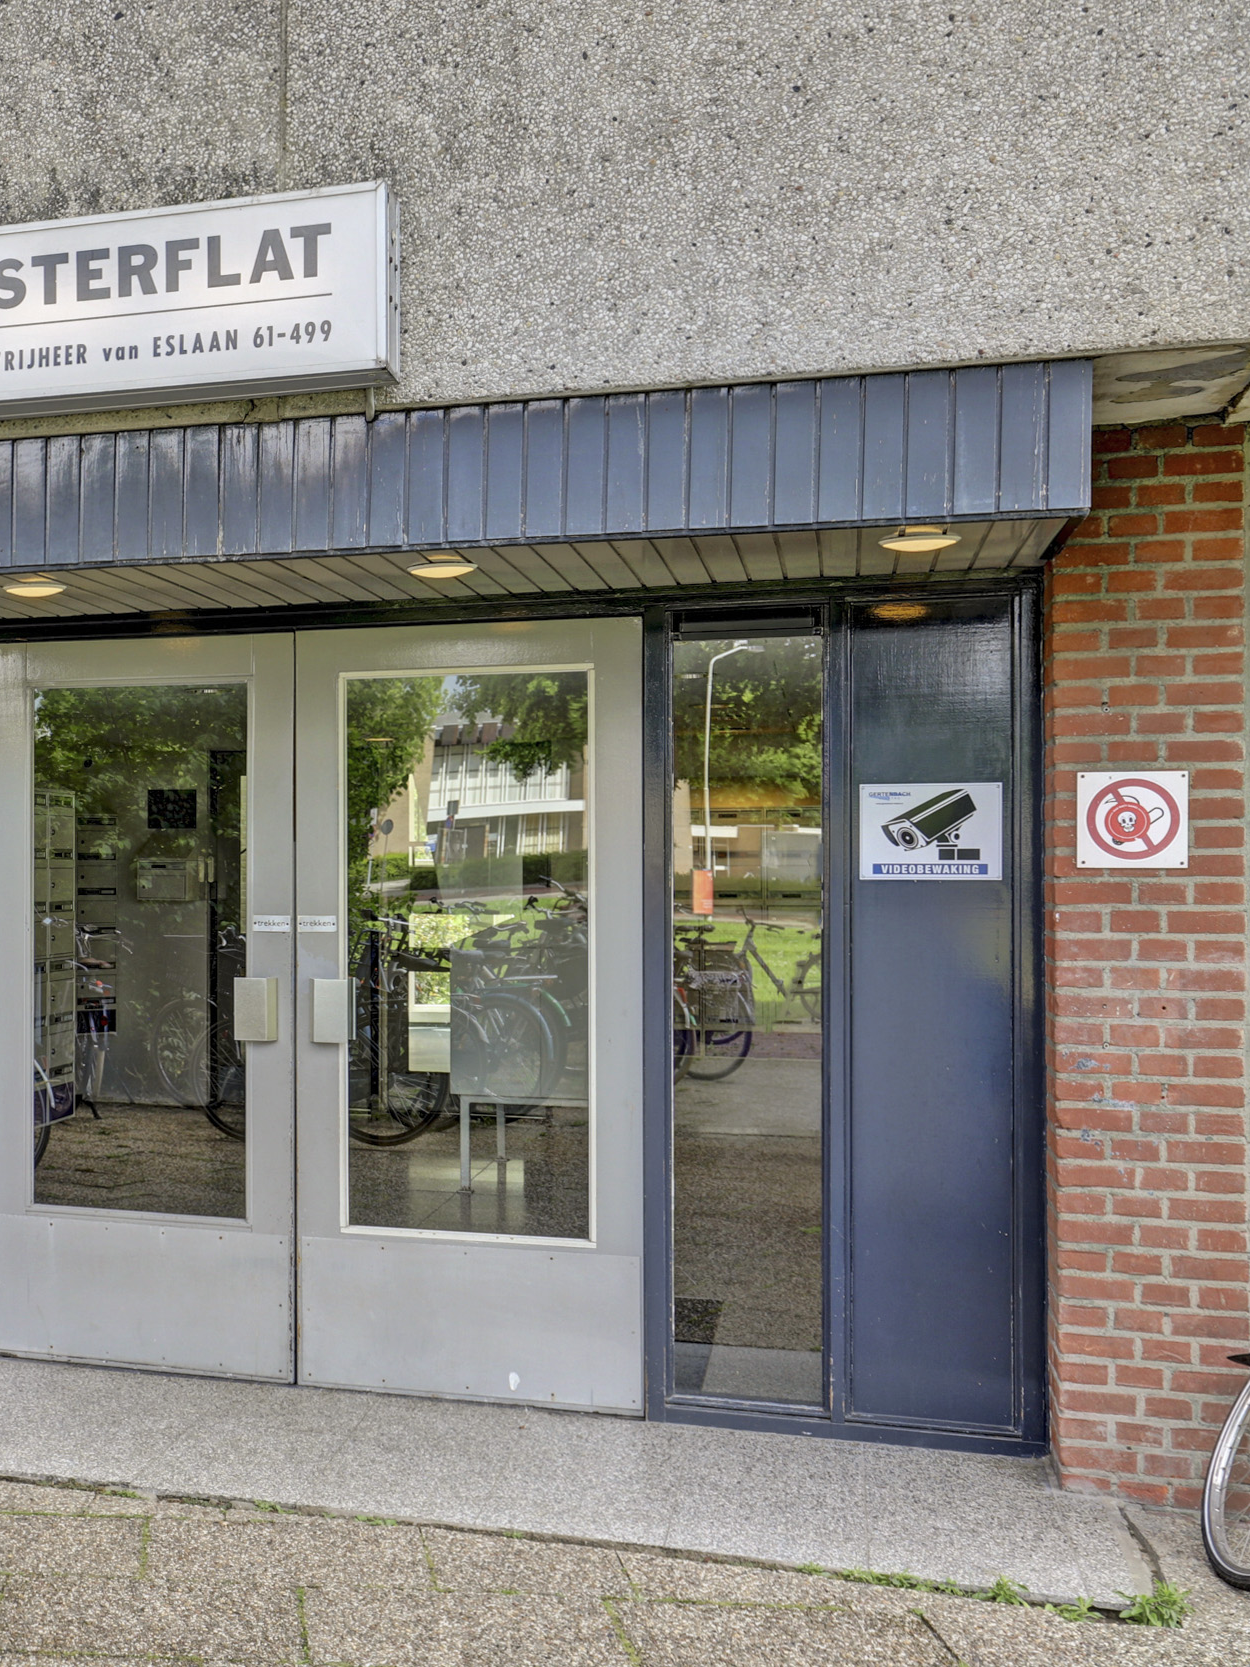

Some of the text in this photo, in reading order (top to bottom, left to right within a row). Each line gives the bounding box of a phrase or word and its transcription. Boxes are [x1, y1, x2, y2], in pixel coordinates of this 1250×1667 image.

[102, 342, 139, 362] van
[152, 328, 238, 358] ESLAAN
[252, 319, 332, 349] 61-499
[880, 864, 980, 874] VIDEOBEWAKING
